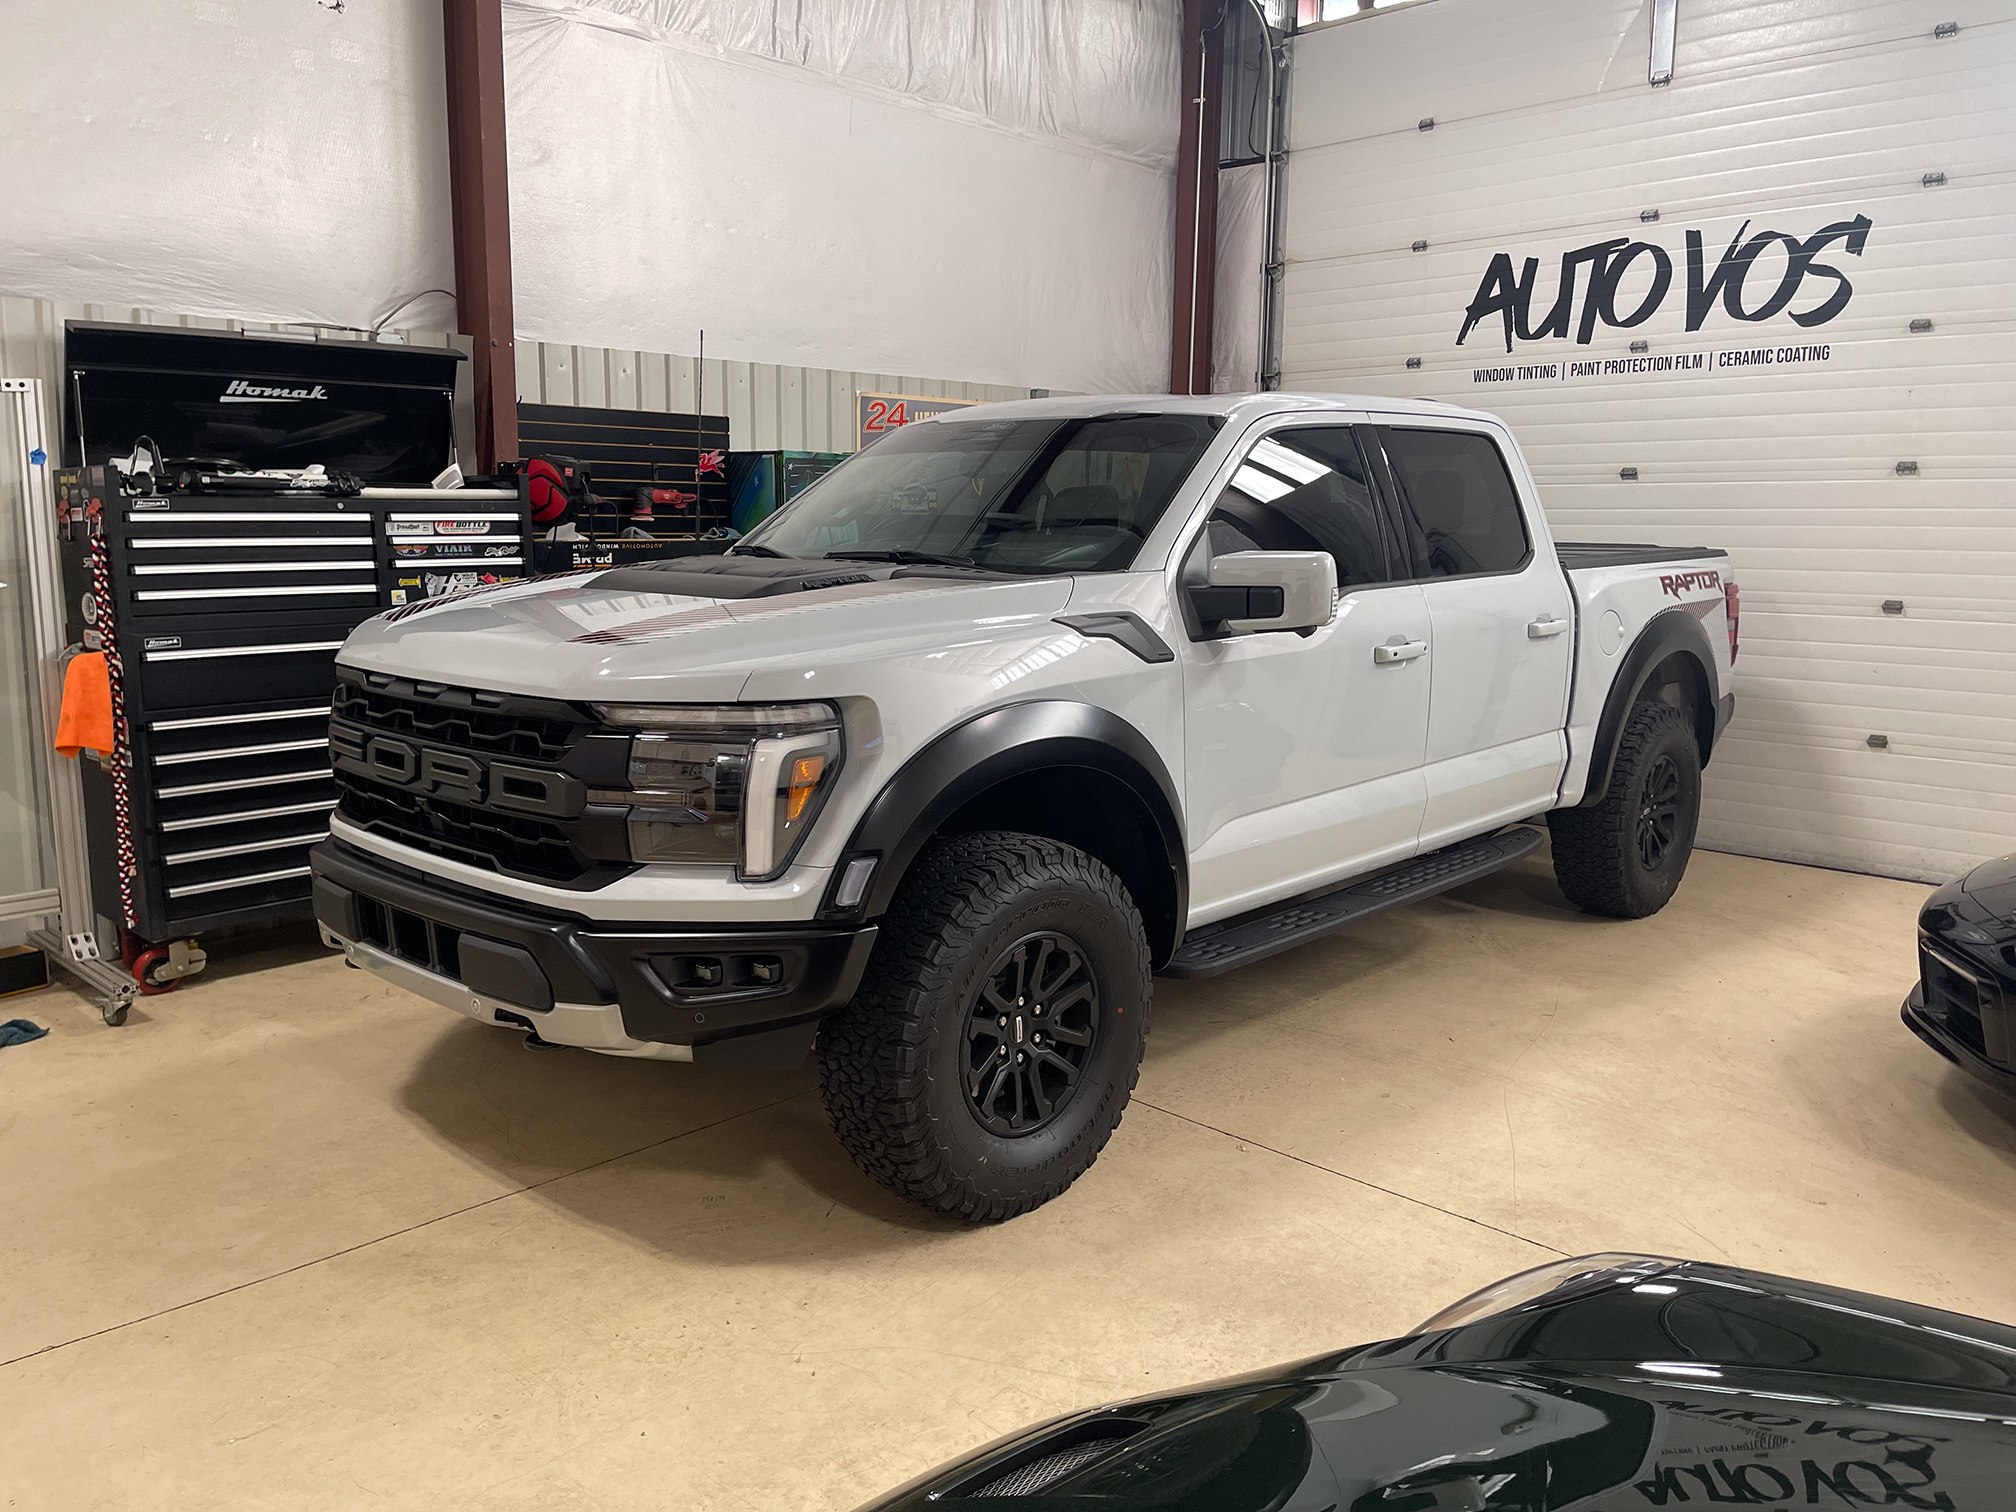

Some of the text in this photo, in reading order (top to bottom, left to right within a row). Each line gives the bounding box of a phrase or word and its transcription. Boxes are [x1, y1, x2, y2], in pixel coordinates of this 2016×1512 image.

[1455, 213, 1873, 353] AUTO VOS
[1473, 345, 1831, 383] WINDOW TINTING PAINT PROTECTION FILM CERAMIC COATING
[226, 380, 328, 400] Homak
[863, 400, 910, 433] 24
[1659, 570, 1724, 601] RAPTOR
[329, 722, 587, 820] FORD
